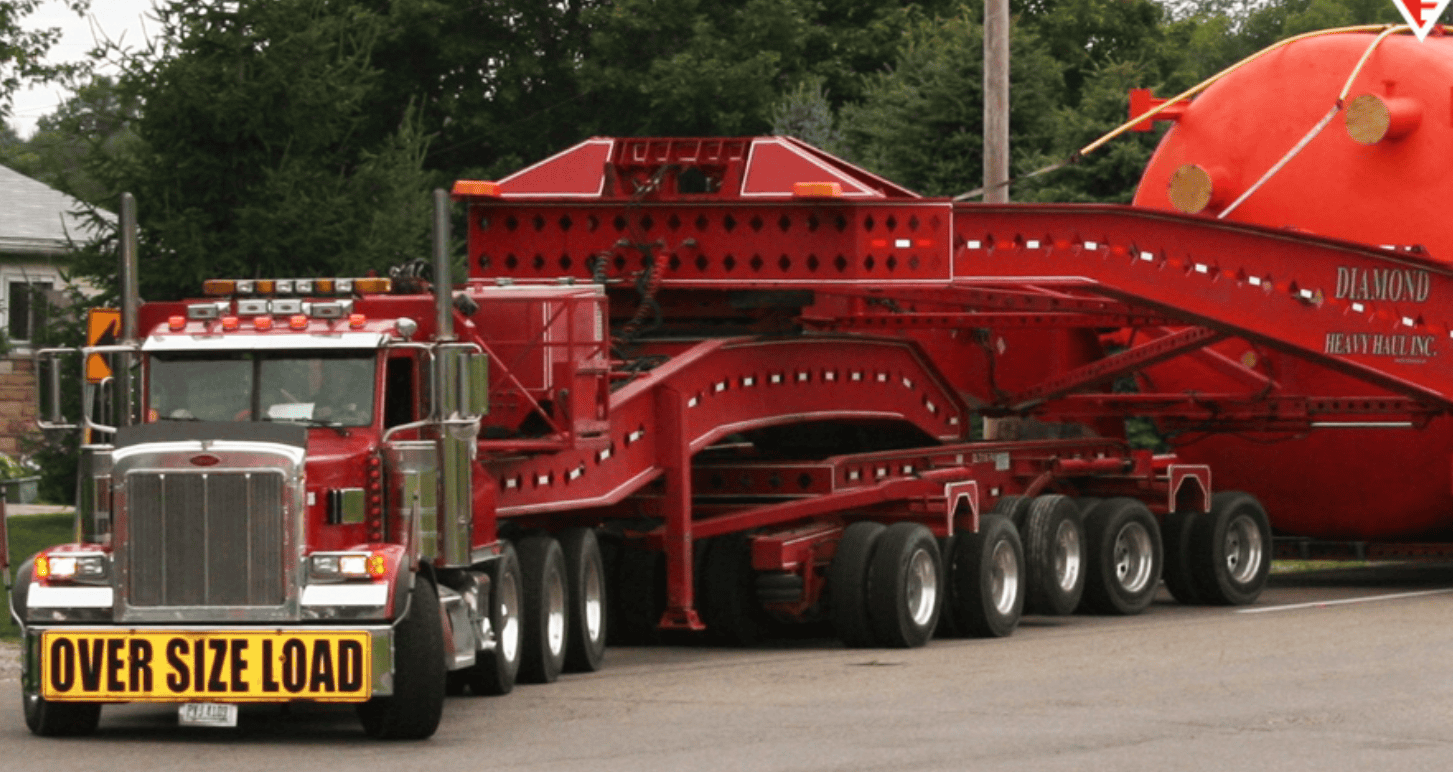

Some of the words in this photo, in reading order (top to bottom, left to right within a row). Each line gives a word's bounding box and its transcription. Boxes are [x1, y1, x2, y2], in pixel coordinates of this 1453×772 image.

[1335, 267, 1430, 302] DIAMOND
[1325, 333, 1370, 355] HEAVY
[1373, 334, 1407, 356] HAUL
[1410, 335, 1438, 357] INC.
[51, 637, 154, 693] OVER
[166, 637, 249, 693] SIZE
[262, 637, 364, 693] LOAD
